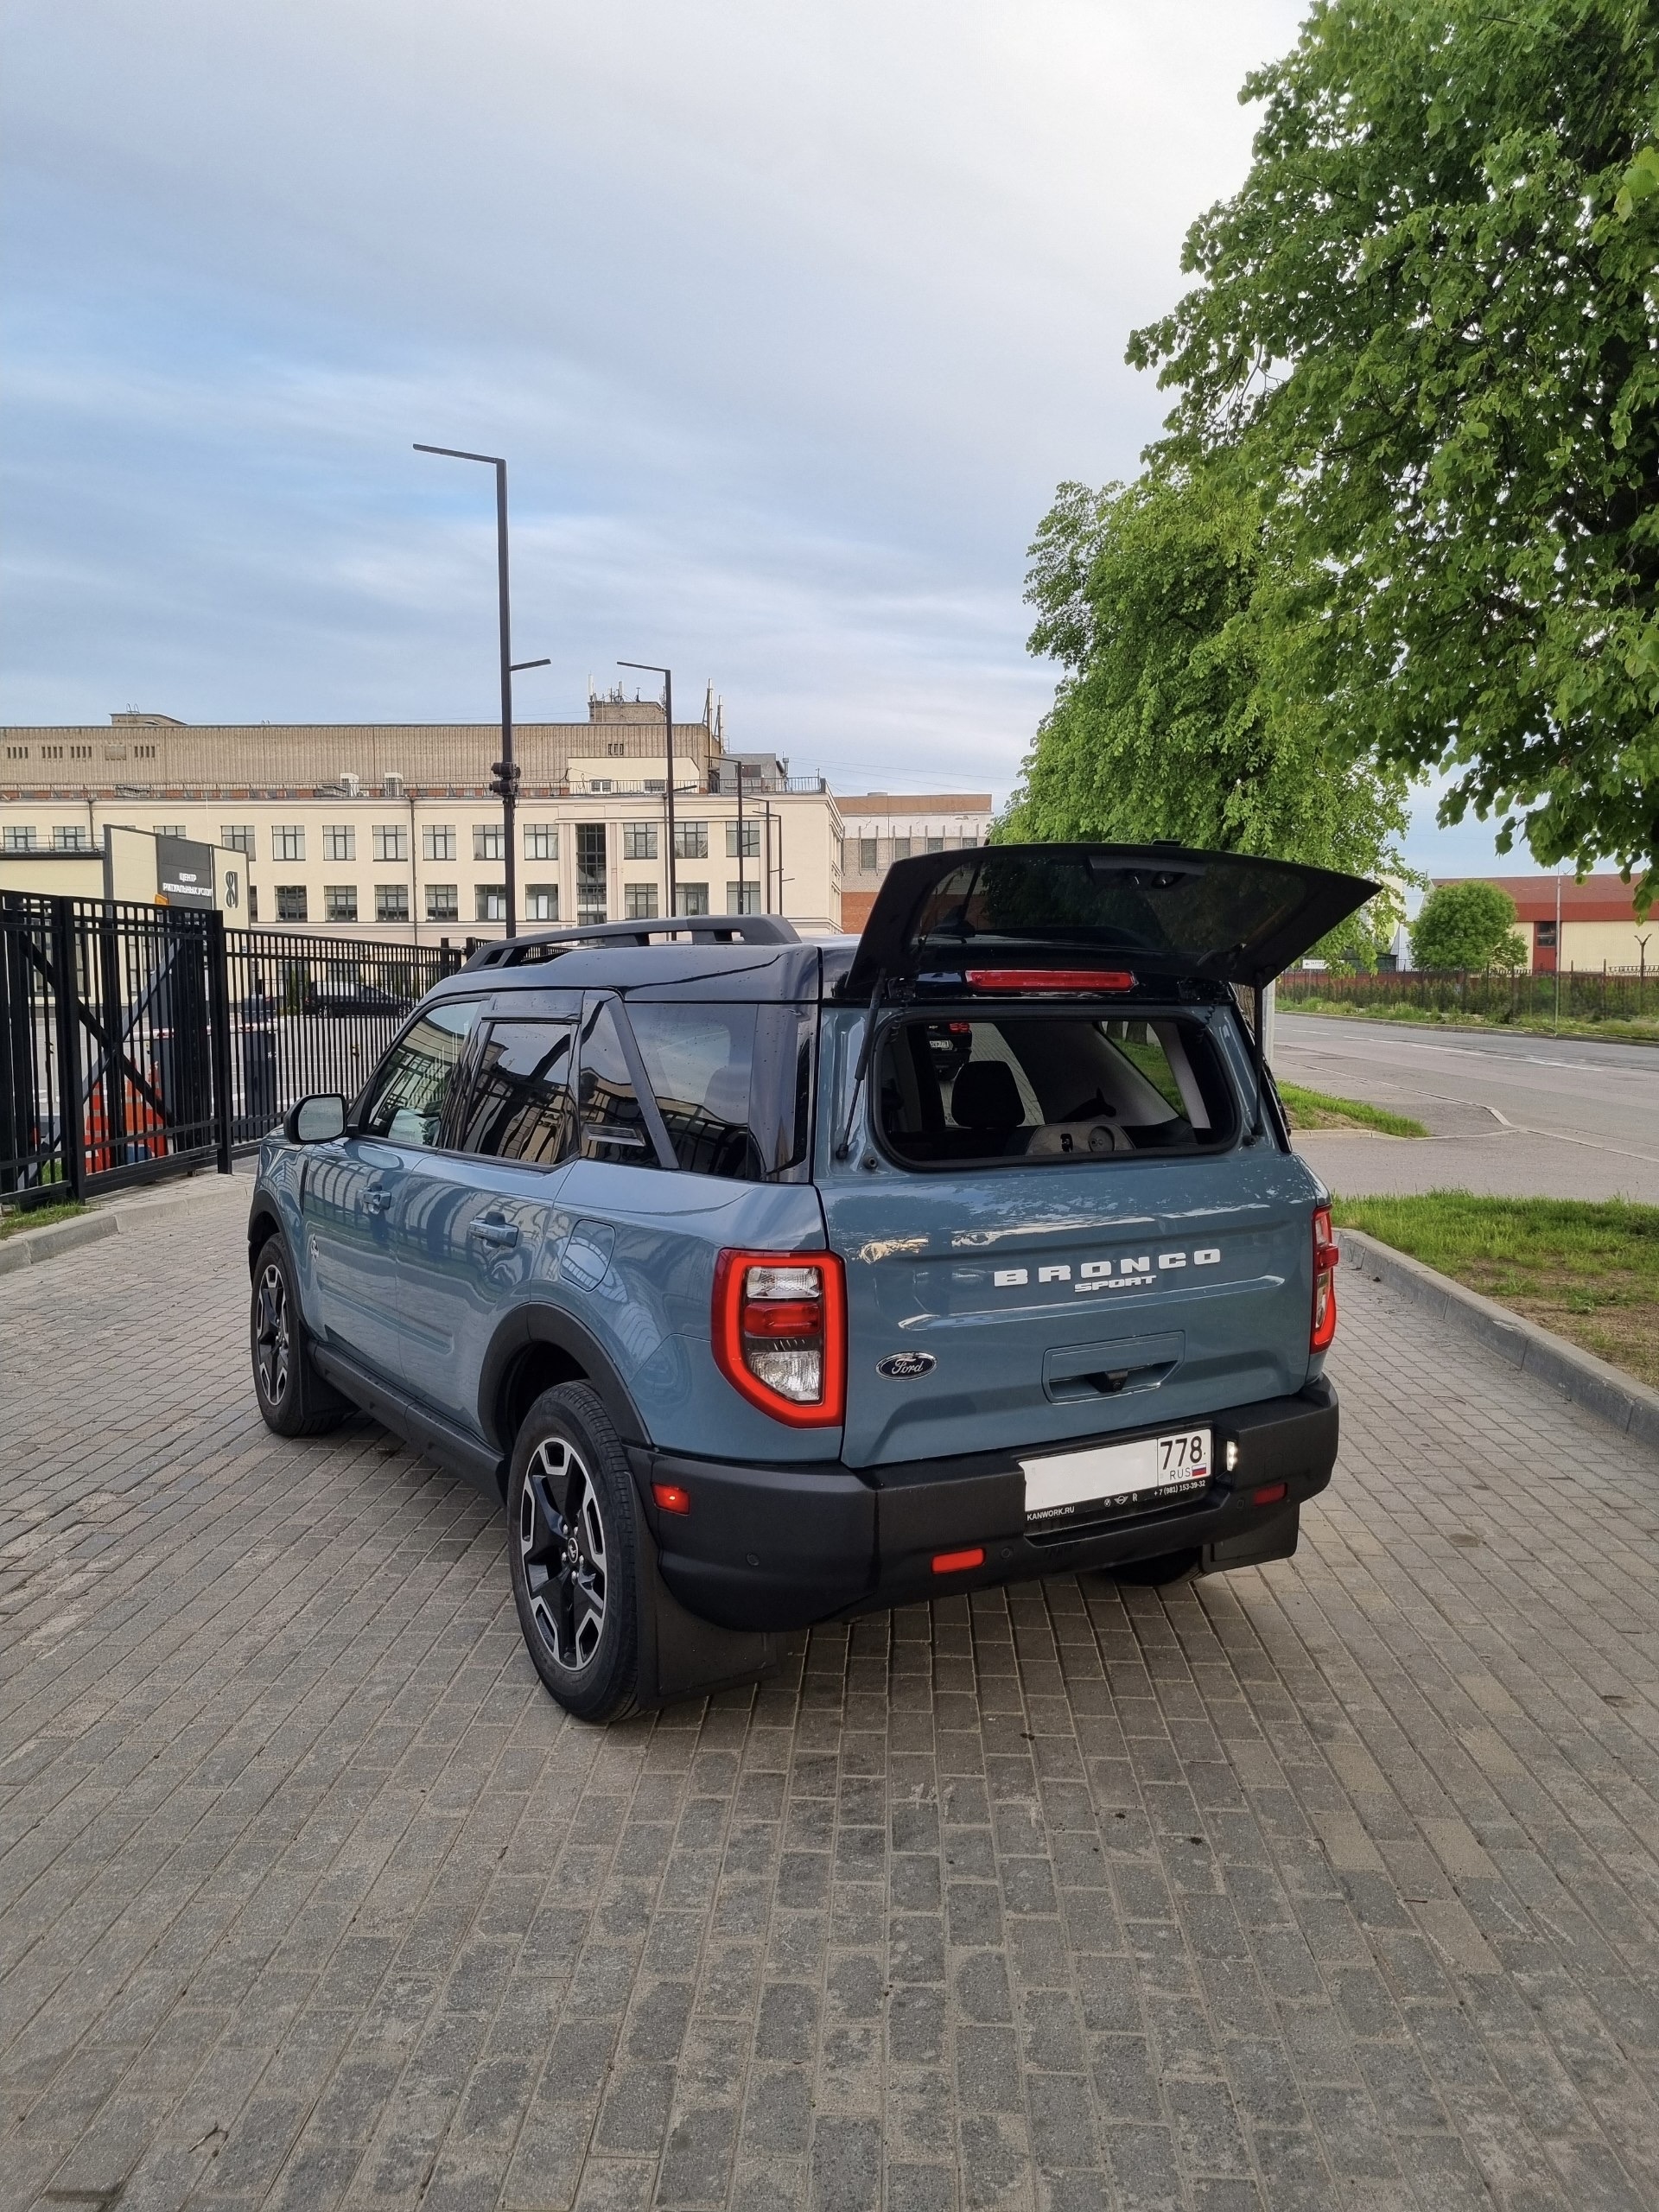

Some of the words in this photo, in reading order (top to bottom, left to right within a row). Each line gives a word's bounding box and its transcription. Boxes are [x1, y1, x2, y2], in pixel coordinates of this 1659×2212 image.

[179, 872, 197, 882] ЦЕНТР
[994, 1249, 1221, 1287] BRONCO
[1074, 1274, 1157, 1293] SPORT
[891, 1357, 925, 1375] Ford
[1160, 1435, 1203, 1470] 778
[1169, 1467, 1191, 1480] RUS
[1163, 1484, 1179, 1496] (981)
[1179, 1480, 1206, 1491] 153-39-32
[1027, 1506, 1075, 1521] KANWORK.RU
